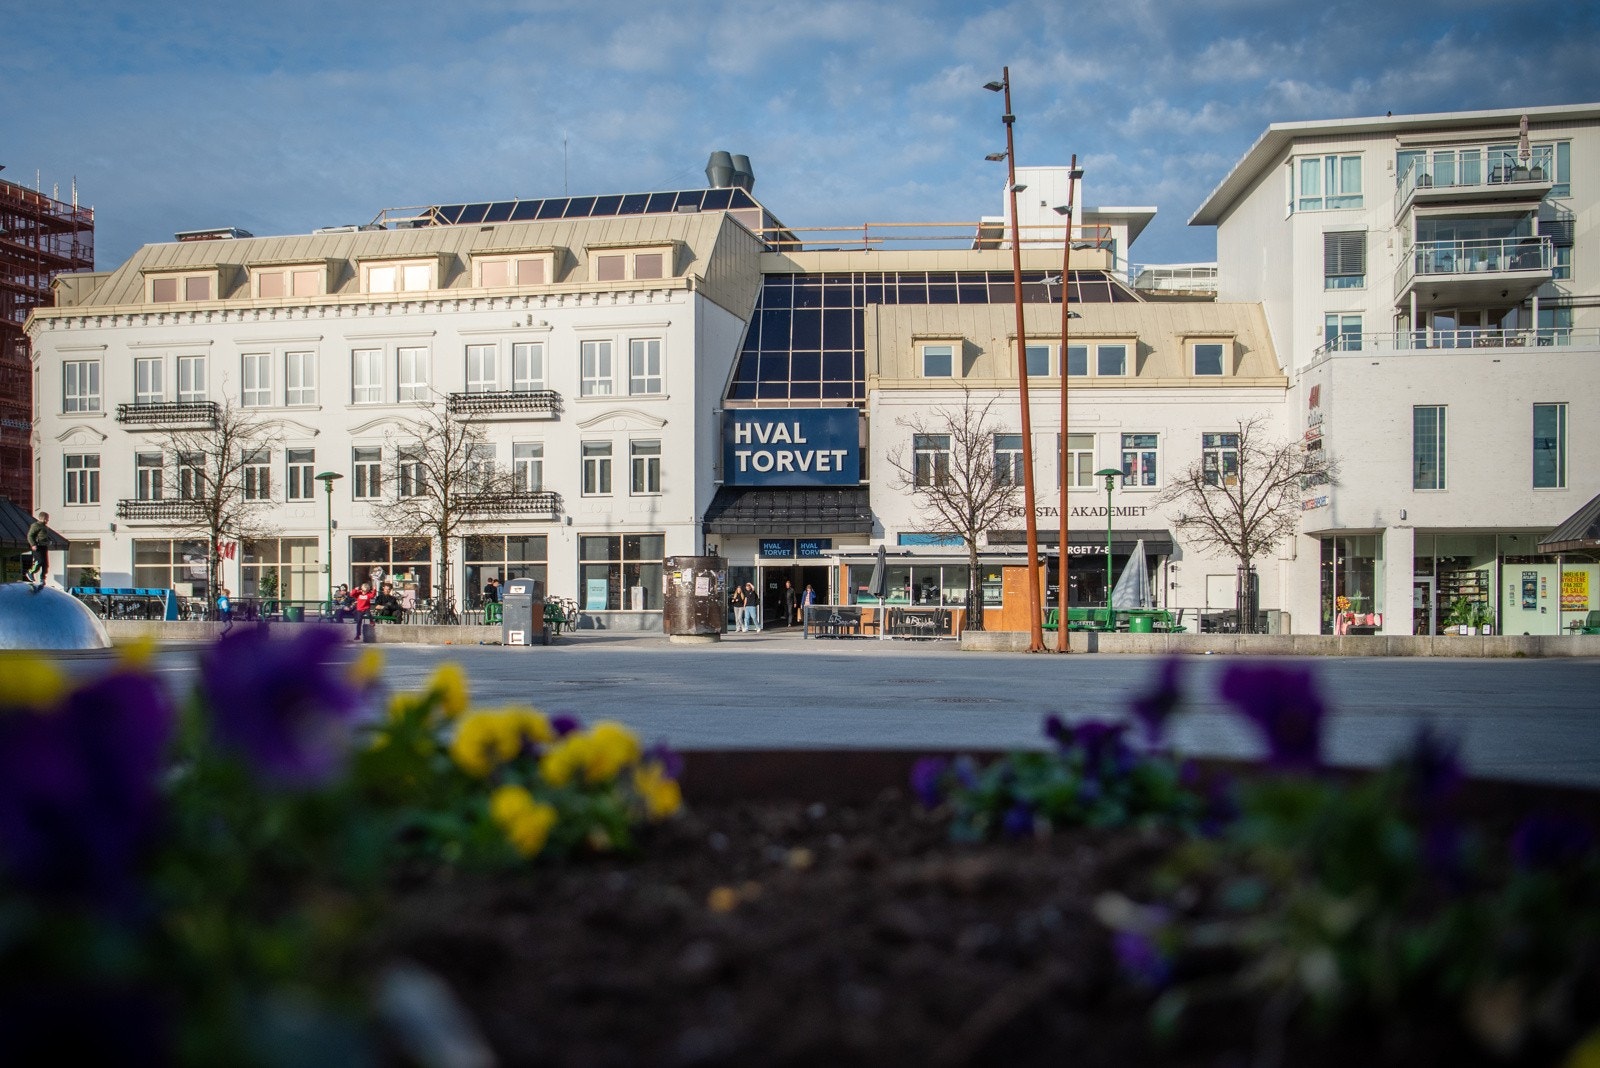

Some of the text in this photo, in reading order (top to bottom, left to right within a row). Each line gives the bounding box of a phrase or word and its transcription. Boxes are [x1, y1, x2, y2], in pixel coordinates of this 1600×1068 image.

[735, 422, 807, 444] HVAL
[735, 450, 848, 472] TORVET
[1008, 506, 1148, 517] GOSTA AKADEMIET
[1054, 545, 1092, 554] TRGET
